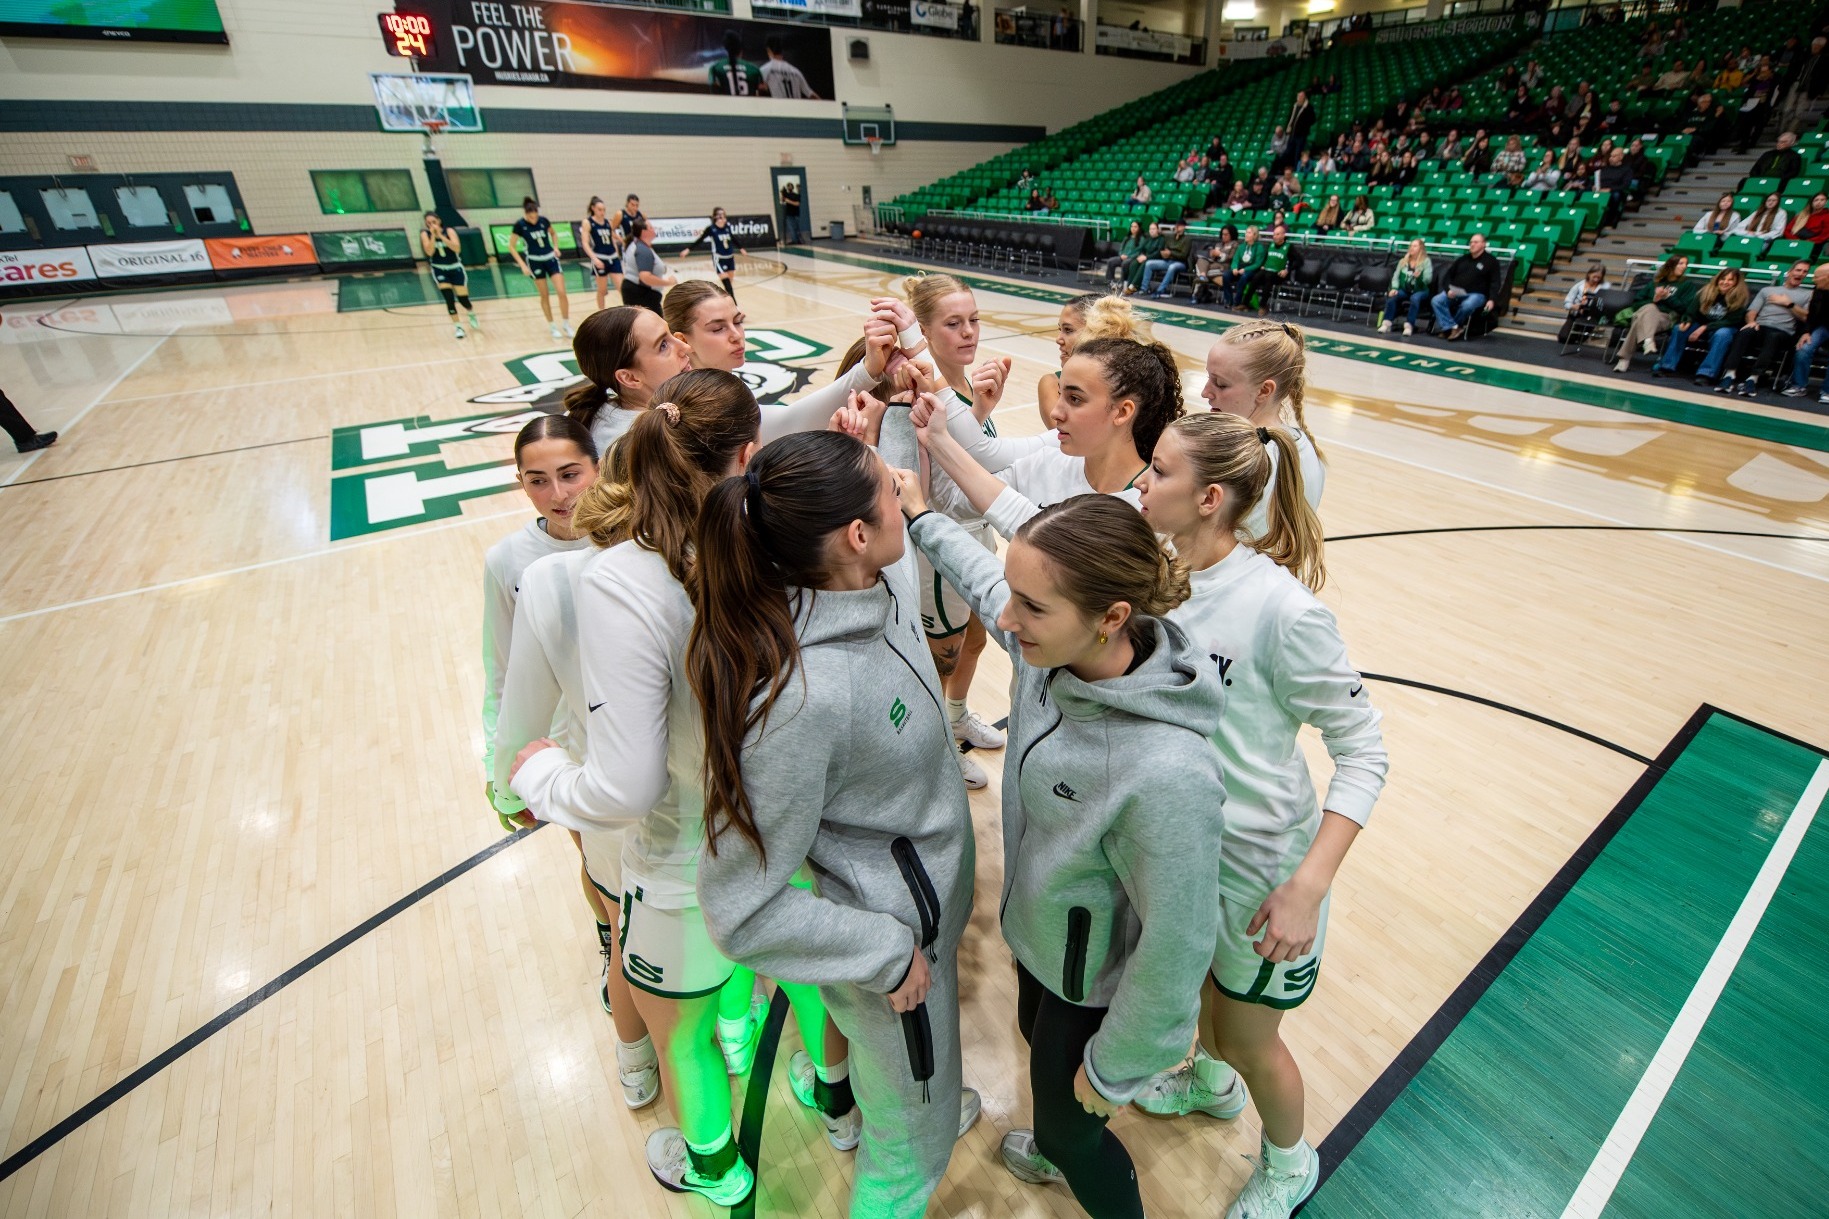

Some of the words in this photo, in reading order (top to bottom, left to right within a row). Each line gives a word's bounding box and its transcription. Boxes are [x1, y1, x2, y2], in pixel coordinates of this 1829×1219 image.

[385, 14, 430, 34] 10:00
[471, 1, 512, 27] FEEL
[511, 4, 546, 29] THE
[395, 32, 427, 56] 24
[451, 24, 577, 72] POWER
[728, 220, 769, 235] utrien
[118, 253, 188, 267] ORIGINAL
[190, 253, 205, 263] 16
[0, 261, 78, 281] ares
[1209, 653, 1234, 687] Y.
[1057, 780, 1077, 799] NIKE
